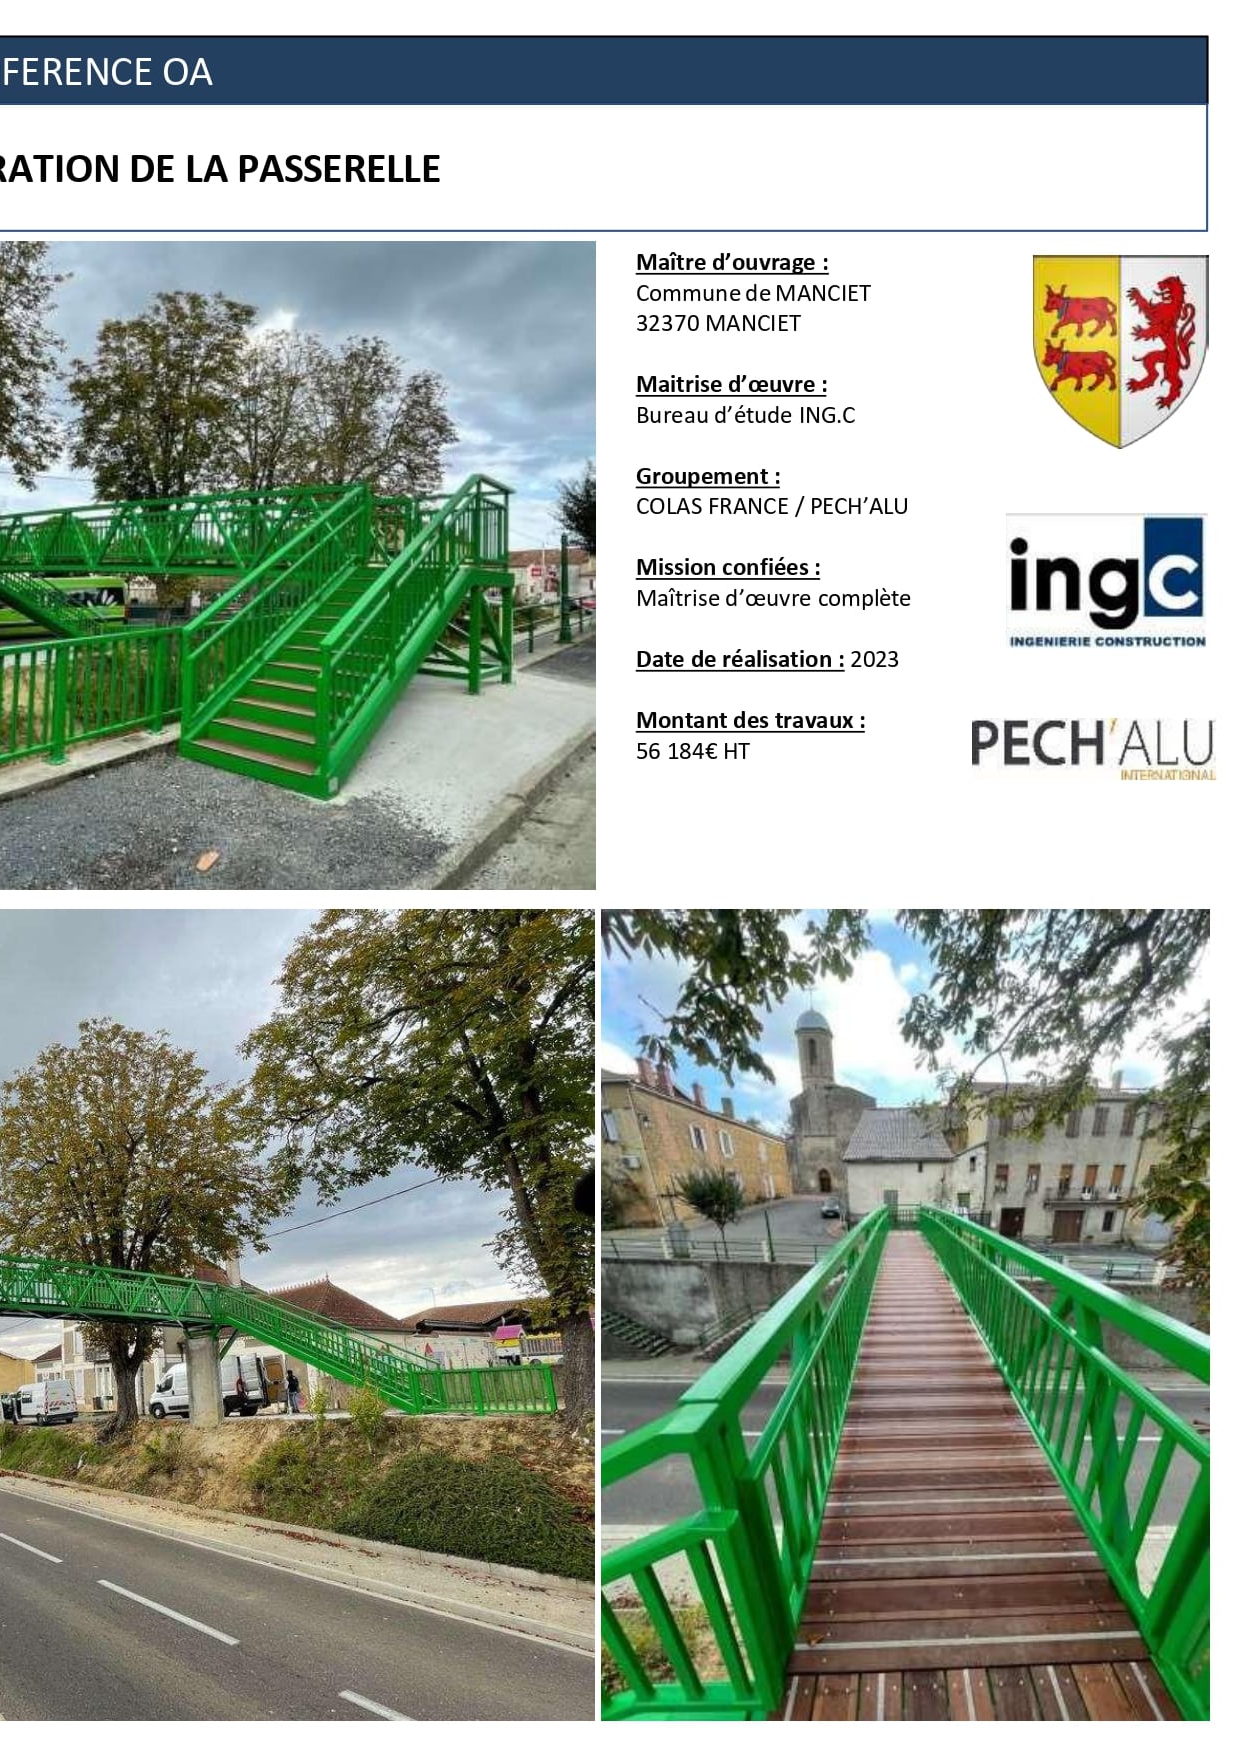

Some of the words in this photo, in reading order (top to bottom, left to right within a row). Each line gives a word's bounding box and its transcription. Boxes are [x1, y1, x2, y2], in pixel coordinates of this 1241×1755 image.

[163, 57, 214, 86] OA
[131, 154, 175, 183] DE
[187, 154, 229, 183] LA
[239, 154, 441, 183] PASSERELLE
[637, 251, 707, 271] Maître
[636, 284, 741, 302] Commune
[745, 283, 771, 302] de
[776, 284, 872, 302] MANCIET
[636, 314, 700, 332] 32370
[706, 314, 802, 332] MANCIET
[637, 374, 723, 393] Maitrise
[637, 406, 709, 424] Bureau
[800, 406, 856, 424] ING.C
[636, 467, 769, 487] Groupement
[636, 497, 703, 515] COLAS
[709, 497, 789, 515] FRANCE
[637, 557, 716, 576] Mission
[722, 556, 809, 576] confiées
[637, 587, 720, 607] Maîtrise
[818, 587, 911, 611] complète
[1010, 636, 1091, 647] INGENIERIE
[1095, 636, 1207, 647] CONSTRUCTION
[637, 650, 685, 668] Date
[691, 649, 717, 668] de
[722, 648, 832, 668] réalisation
[850, 650, 899, 668] 2023
[637, 711, 728, 729] Montant
[733, 710, 769, 729] des
[774, 712, 854, 729] travaux
[636, 742, 661, 760] 56
[668, 742, 718, 760] 184€
[724, 742, 751, 760] HT
[1120, 769, 1217, 781] INTERNATIONAL
